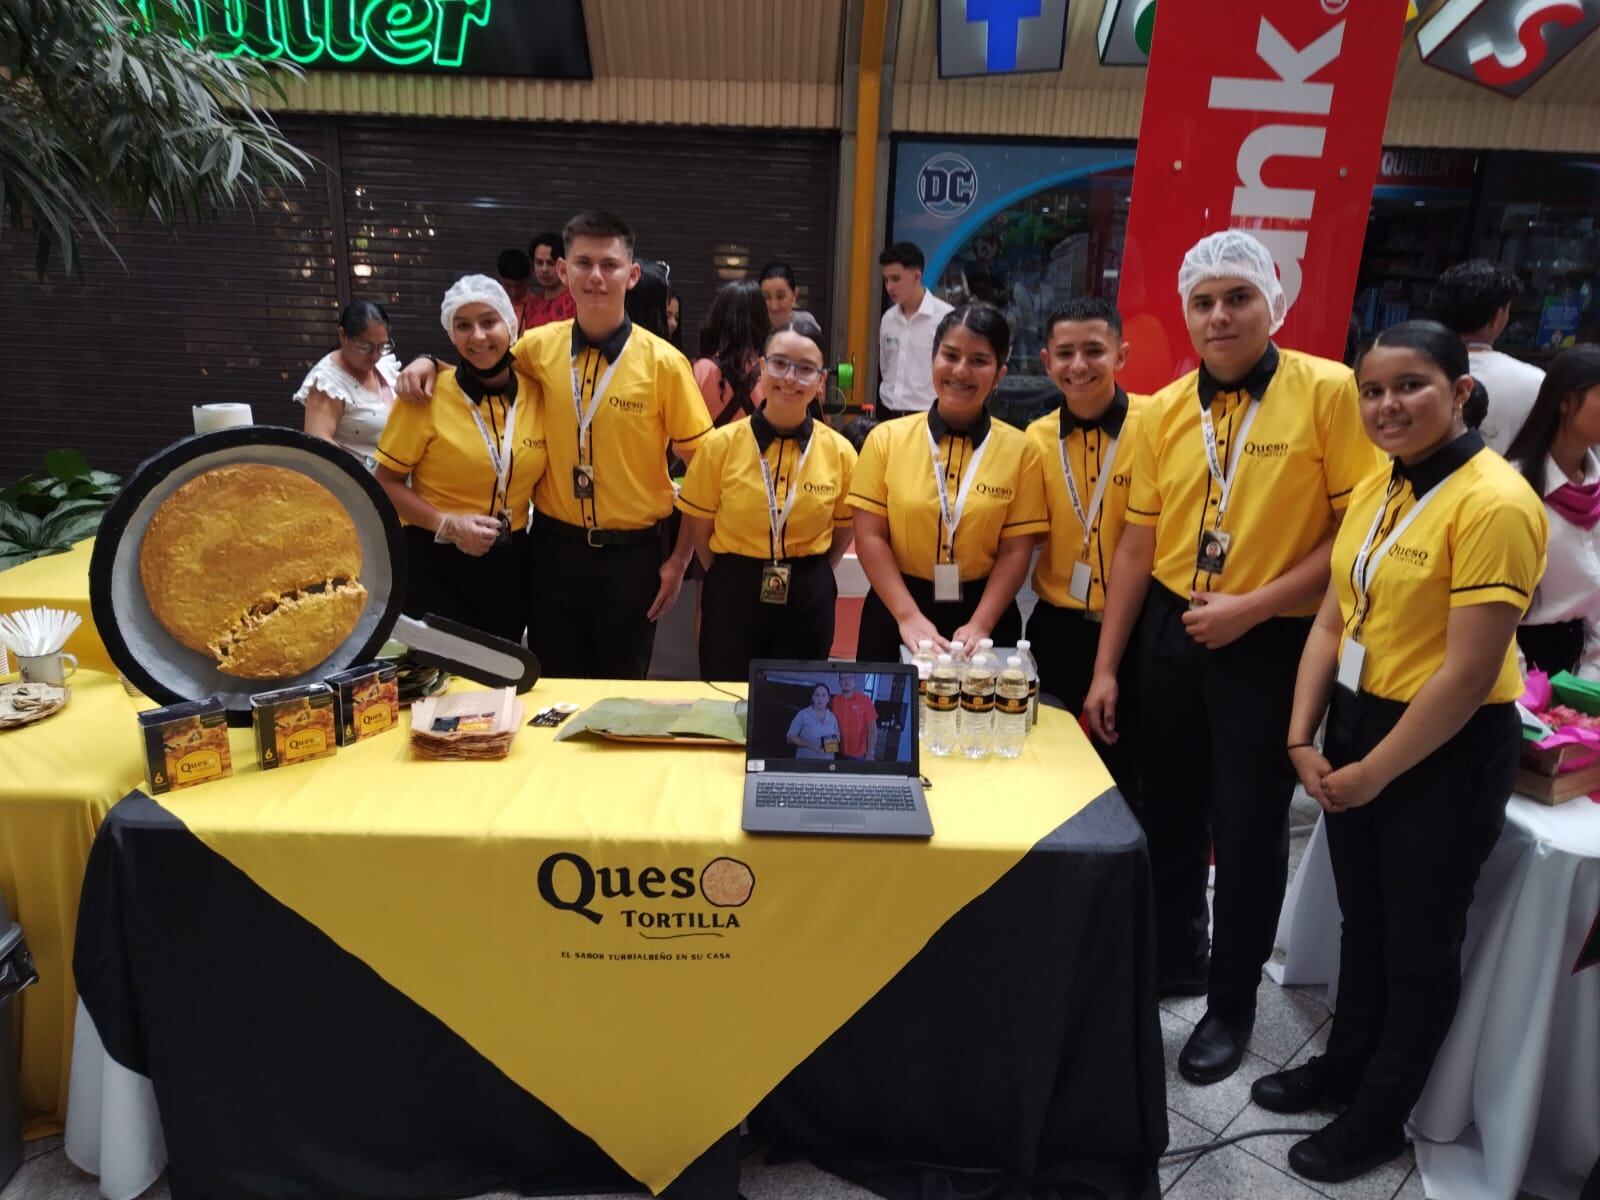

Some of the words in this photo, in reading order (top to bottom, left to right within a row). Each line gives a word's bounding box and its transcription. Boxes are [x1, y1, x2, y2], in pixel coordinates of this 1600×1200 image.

[921, 167, 973, 206] DC
[609, 396, 643, 409] Queso
[1244, 441, 1289, 456] Queso
[803, 482, 835, 494] Queso
[976, 483, 1012, 496] Queso
[345, 724, 352, 736] 6
[265, 748, 273, 760] 6
[154, 772, 164, 785] 6
[620, 909, 741, 929] TORTILLA
[561, 950, 572, 959] EL
[574, 951, 605, 960] SABOR
[608, 951, 673, 962] TURRIALBEÑO
[676, 953, 688, 961] EN
[690, 953, 703, 961] SU
[706, 952, 732, 960] CASA
